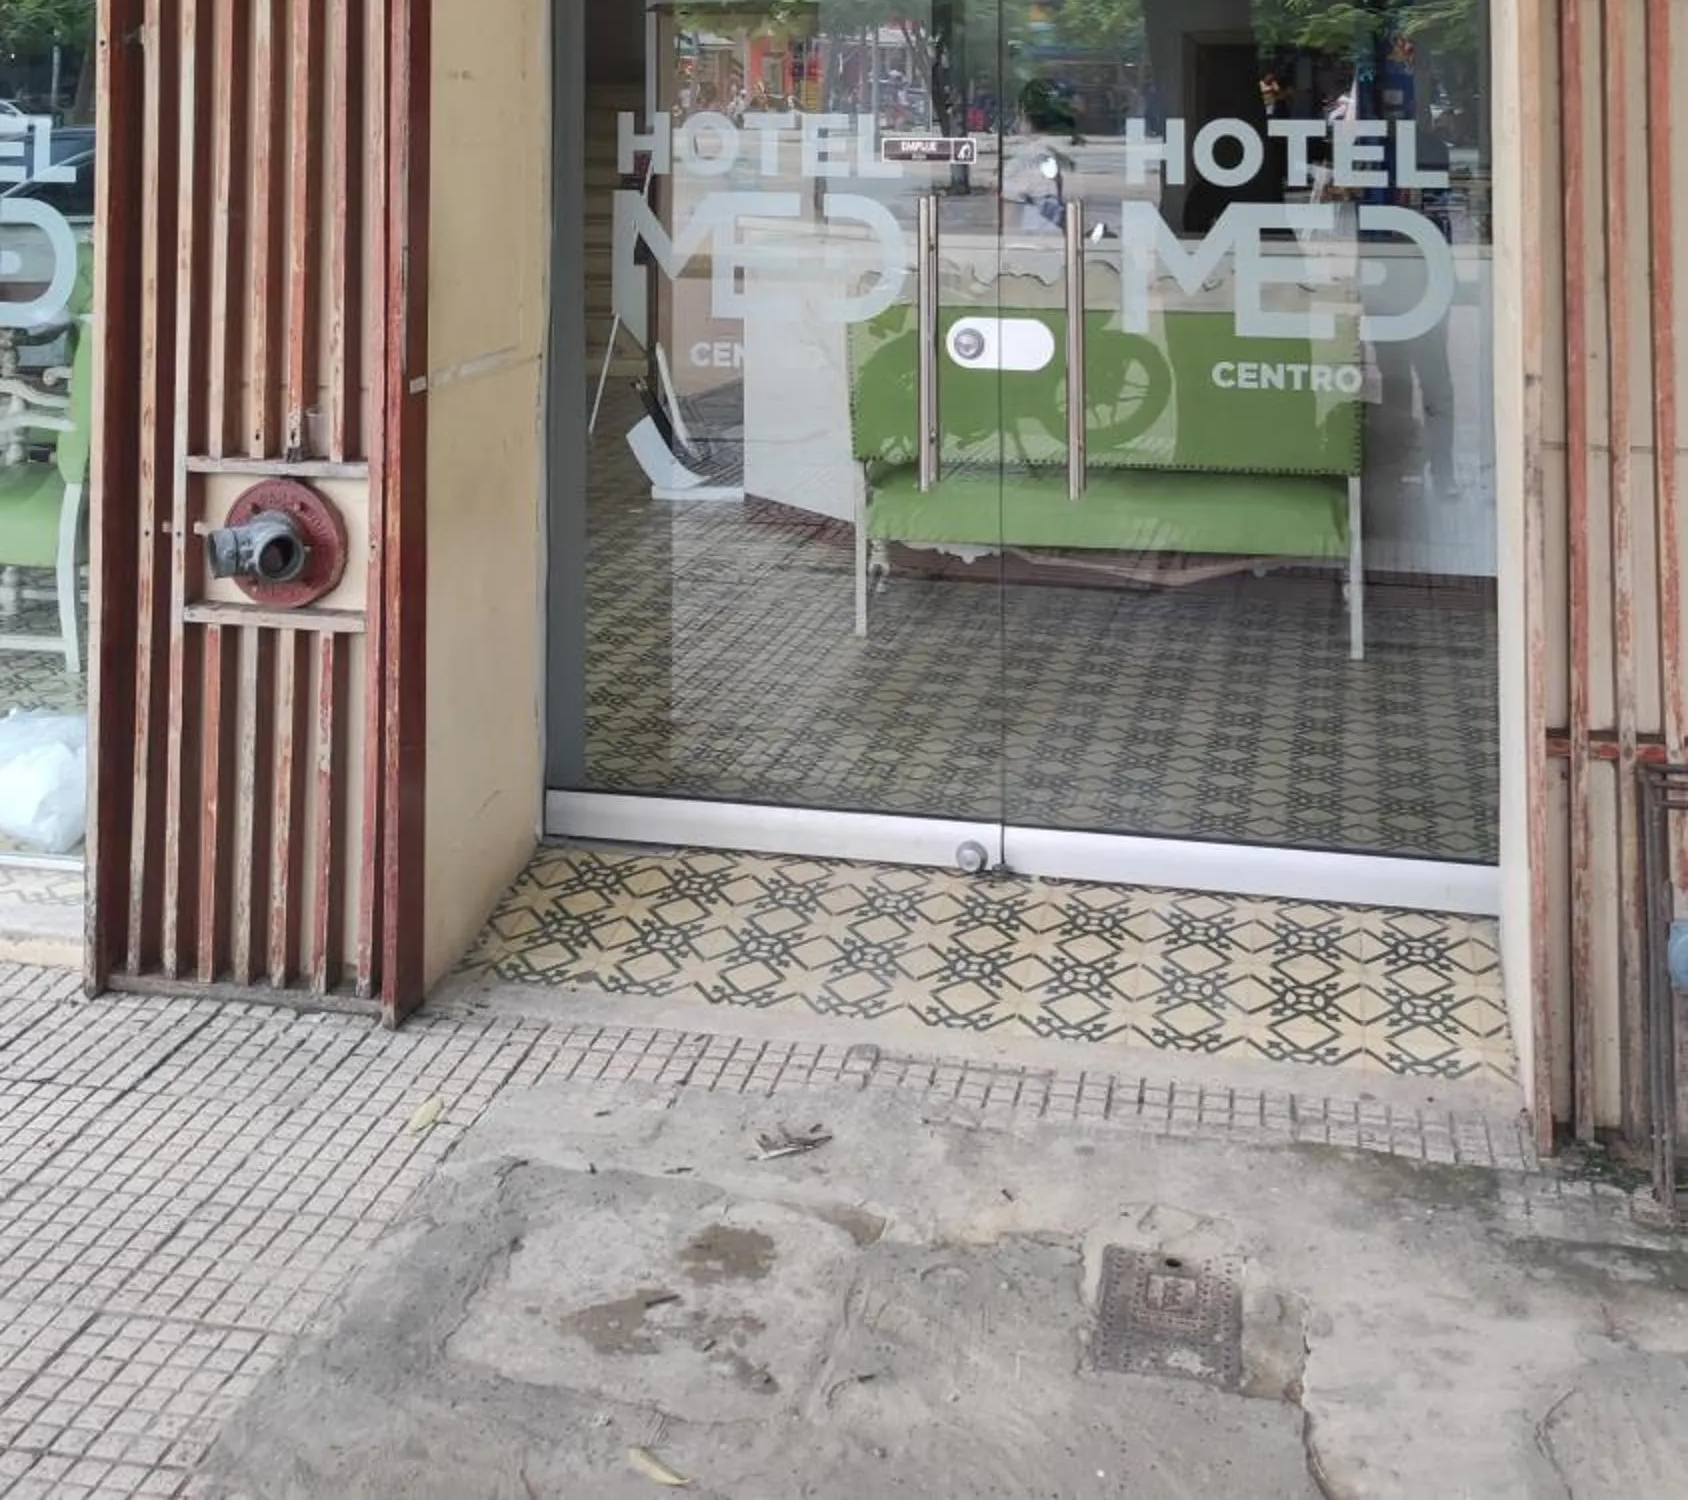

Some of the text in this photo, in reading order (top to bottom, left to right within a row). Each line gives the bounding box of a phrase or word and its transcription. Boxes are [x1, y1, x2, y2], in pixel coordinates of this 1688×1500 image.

[617, 111, 903, 179] HOTEL
[1125, 117, 1449, 189] HOTEL
[612, 189, 907, 324] MED
[1121, 200, 1457, 342] MED
[1211, 360, 1363, 393] CENTRO
